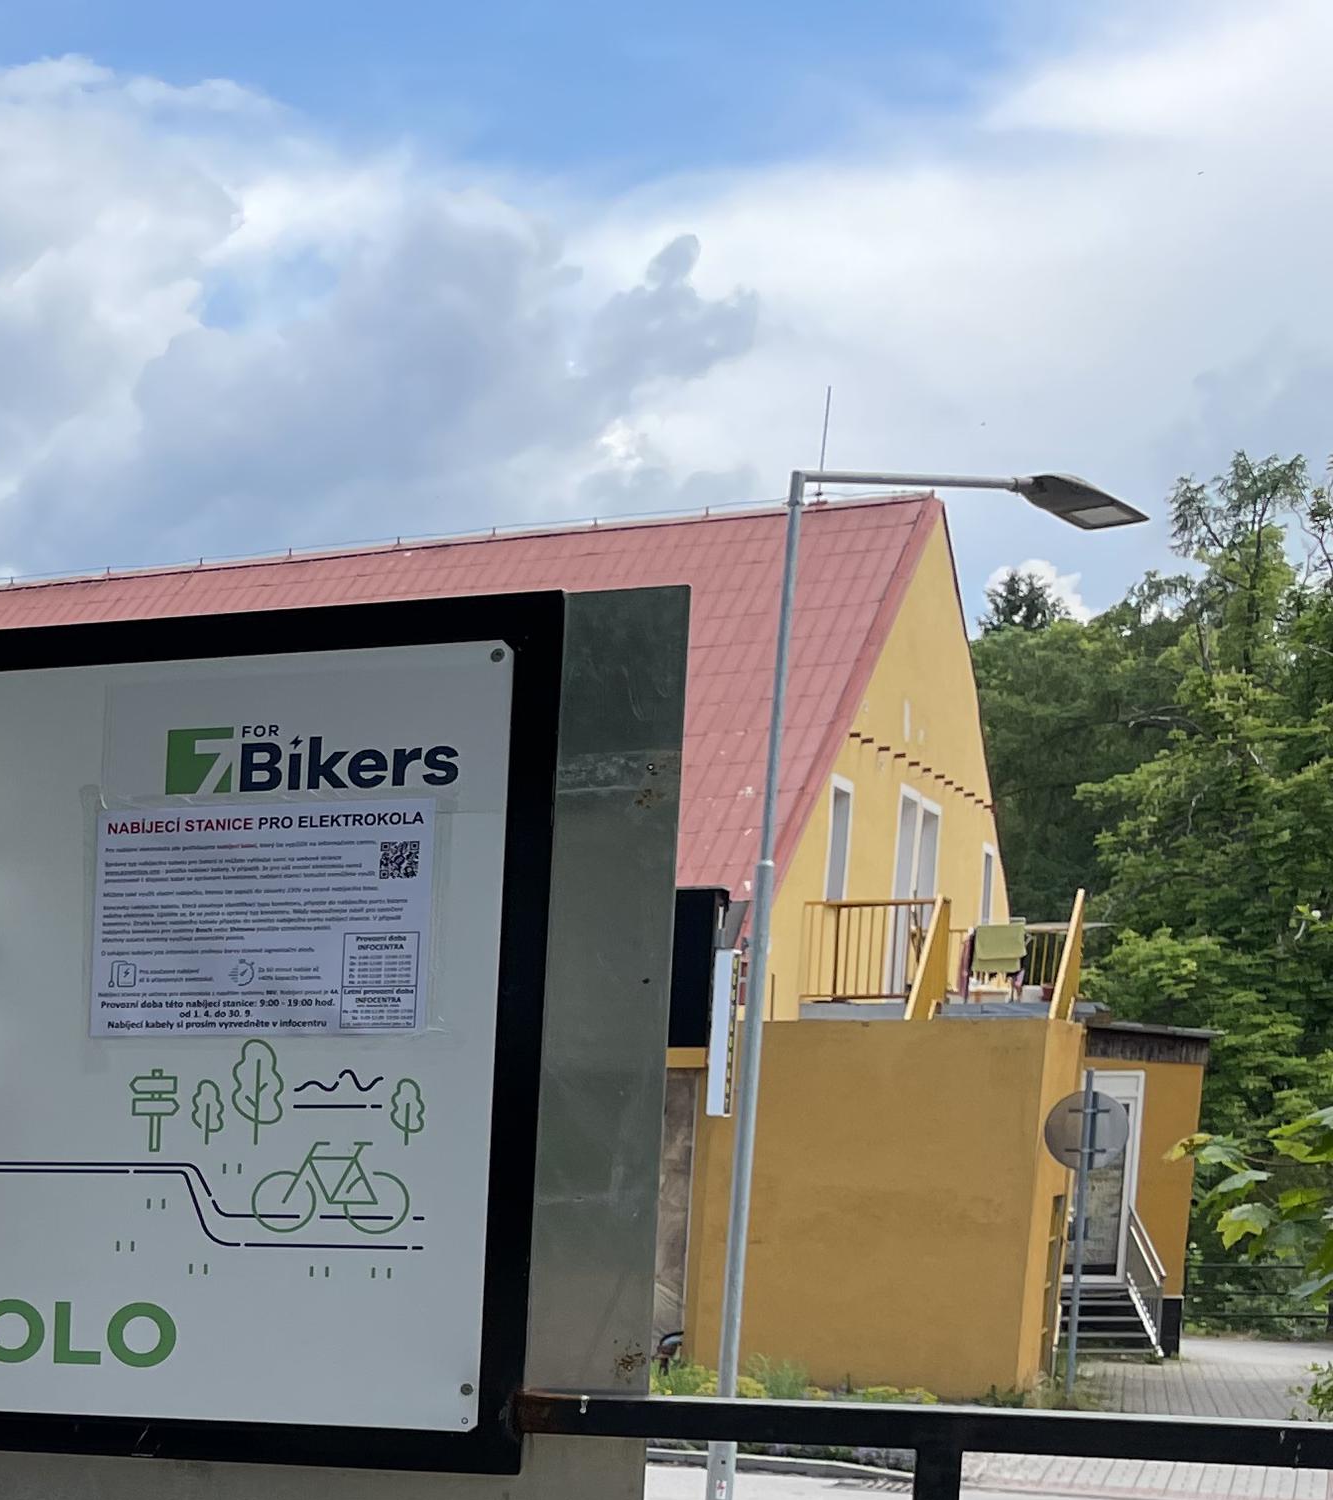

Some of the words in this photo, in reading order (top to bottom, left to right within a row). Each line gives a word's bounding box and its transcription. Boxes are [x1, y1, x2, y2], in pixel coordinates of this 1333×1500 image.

[241, 724, 280, 738] FOR
[239, 735, 459, 793] Bikers
[106, 817, 181, 835] NABÍJECÍ
[184, 817, 253, 832] STANICE
[258, 816, 294, 830] PRO
[298, 811, 425, 829] ELEKTROKOLA
[100, 999, 139, 1009] Provozní
[139, 999, 164, 1009] doba
[165, 999, 184, 1009] této
[185, 998, 220, 1011] nabíjecí
[221, 998, 258, 1008] stanice:
[259, 999, 280, 1008] 9:00
[286, 999, 312, 1008] 19:00
[313, 998, 336, 1008] hod.
[179, 1010, 191, 1019] od
[193, 1010, 201, 1018] 1.
[203, 1010, 212, 1018] 4.
[214, 1010, 226, 1018] do
[228, 1009, 243, 1018] 30.
[244, 1009, 253, 1018] 9.
[107, 1020, 144, 1031] Nabíjecí
[144, 1020, 175, 1031] kabely
[176, 1020, 183, 1030] si
[185, 1020, 217, 1031] prosím
[218, 1019, 271, 1031] vyzvedněte
[280, 1019, 328, 1030] infocentru
